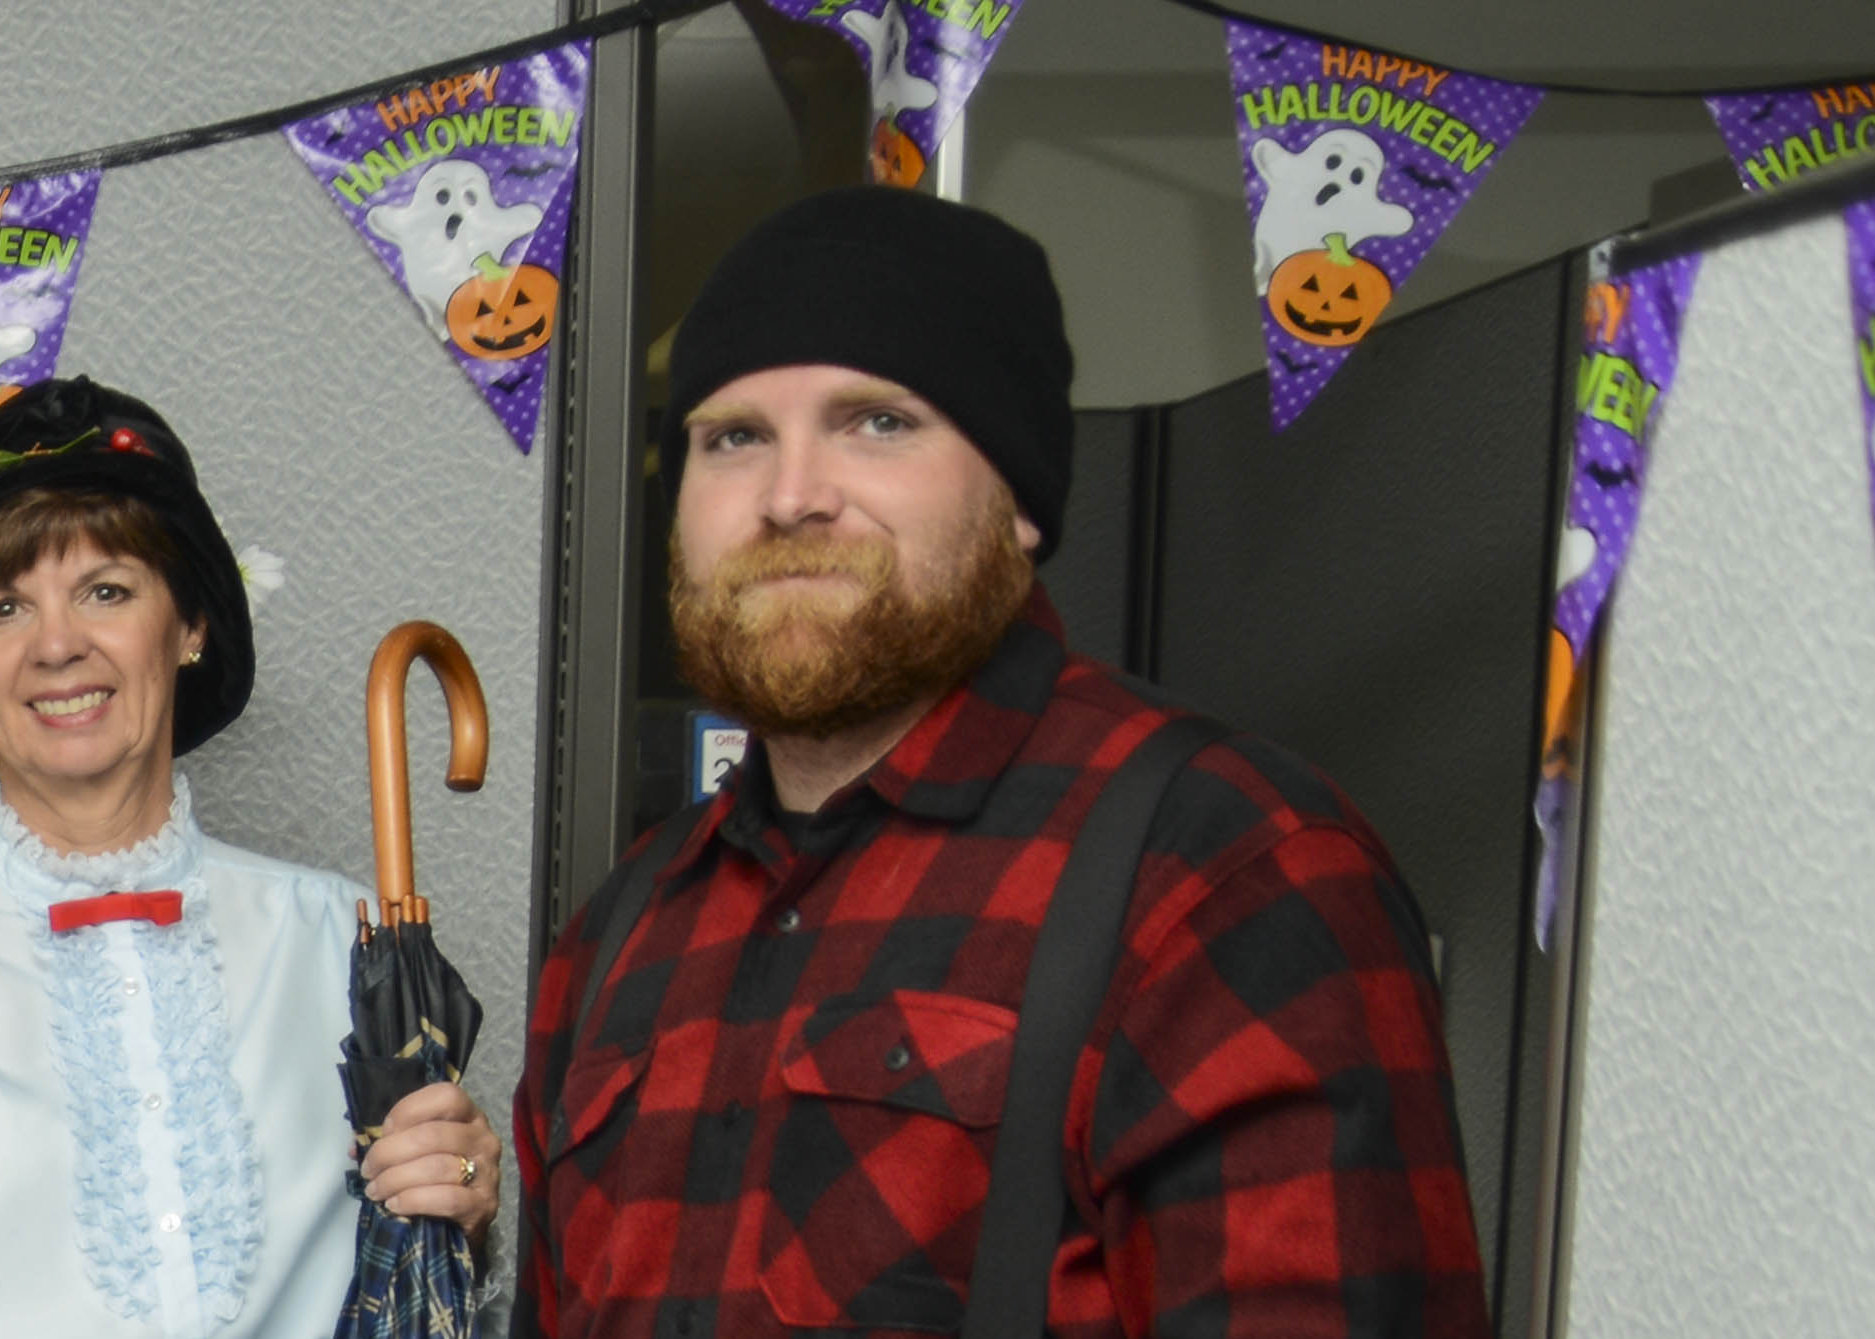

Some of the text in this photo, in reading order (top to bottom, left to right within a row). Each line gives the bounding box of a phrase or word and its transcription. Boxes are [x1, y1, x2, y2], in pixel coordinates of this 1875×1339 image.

[377, 66, 501, 132] HAPPY
[1322, 44, 1449, 96] HAPPY
[332, 106, 576, 206] HALLOWEEN
[1242, 83, 1495, 173] HALLOWEEN
